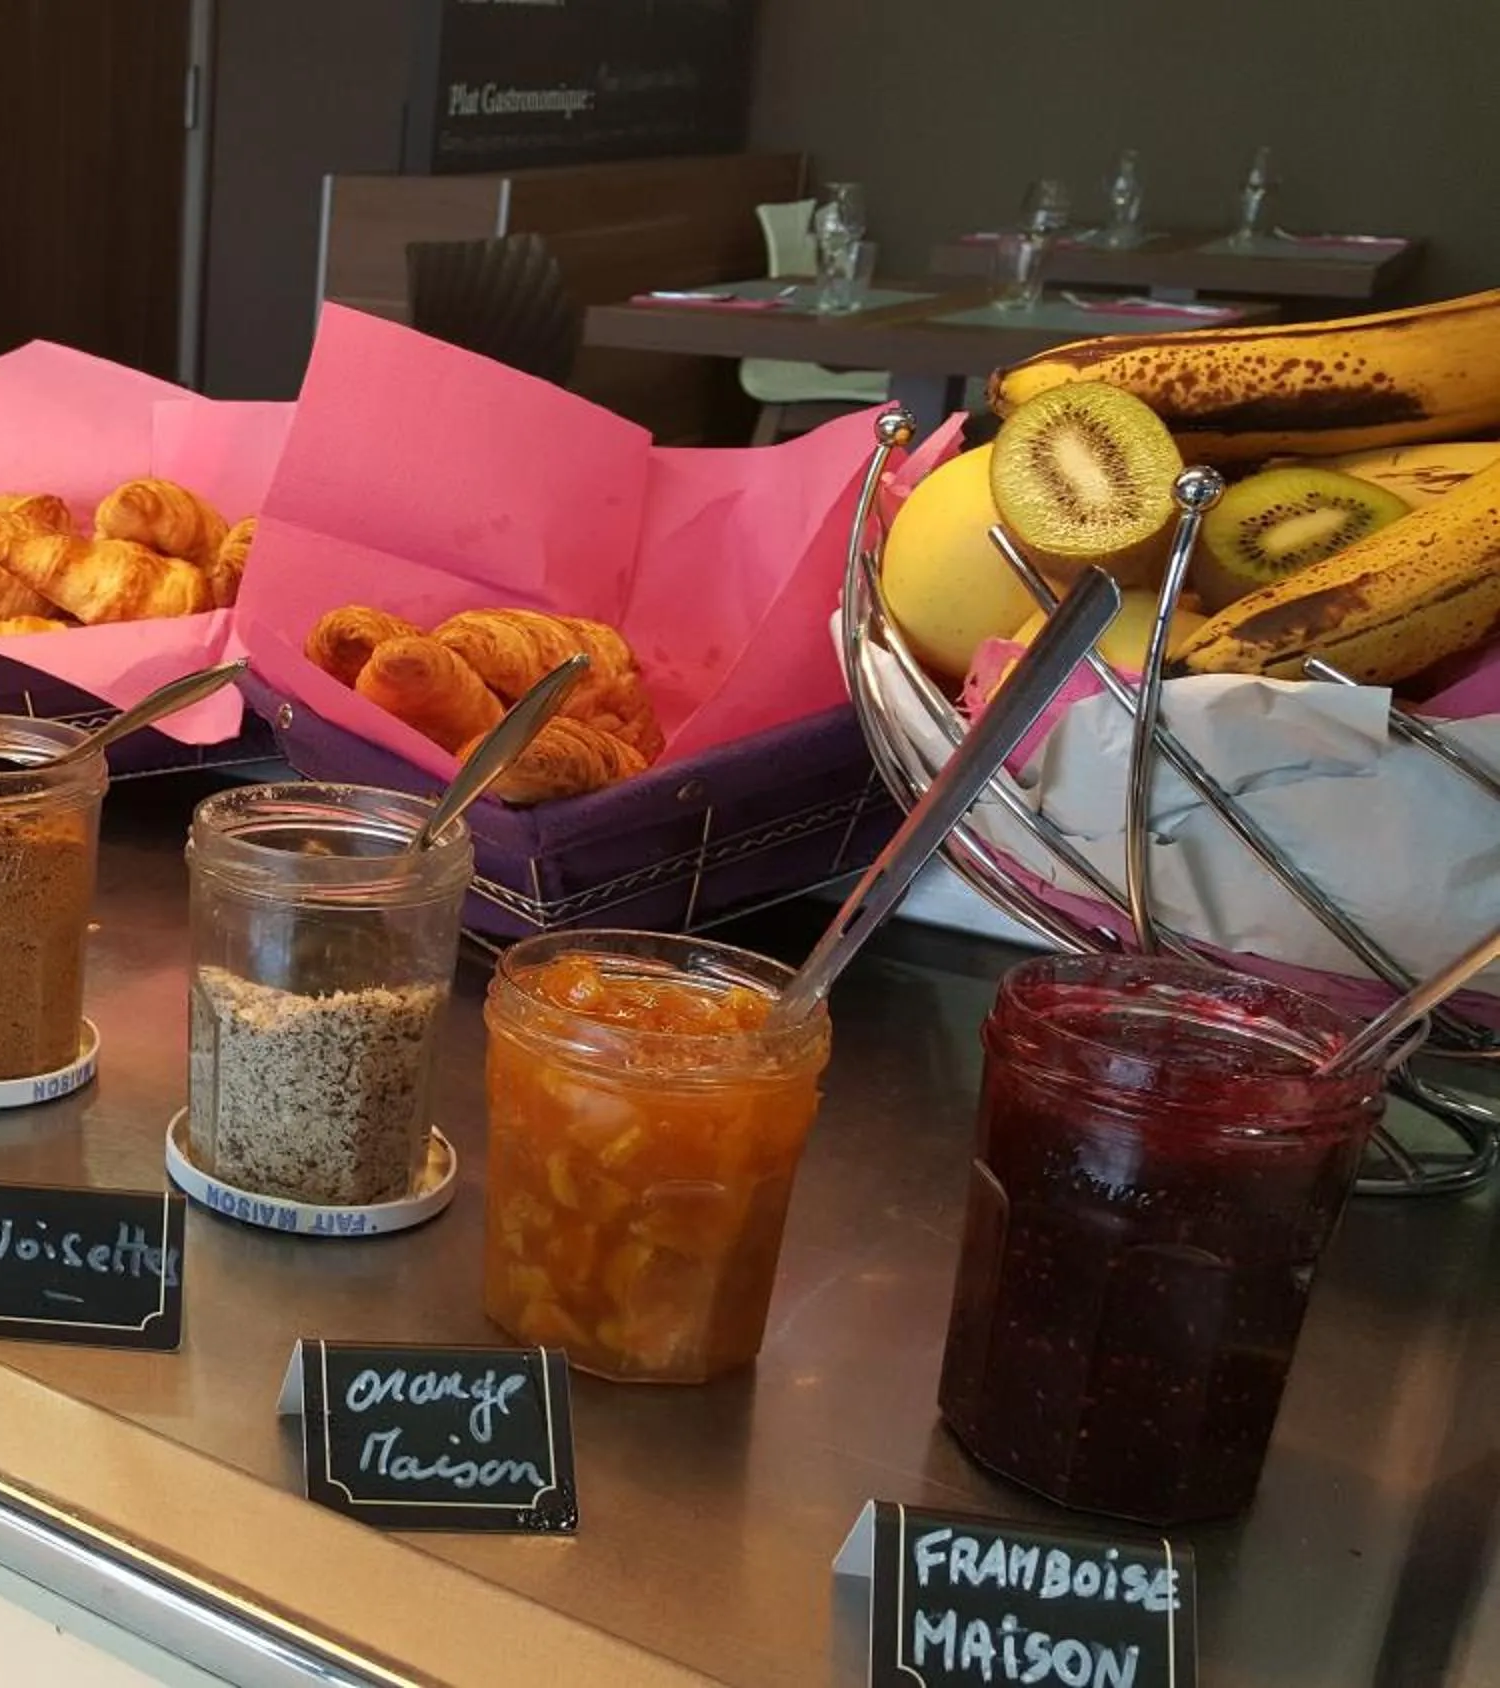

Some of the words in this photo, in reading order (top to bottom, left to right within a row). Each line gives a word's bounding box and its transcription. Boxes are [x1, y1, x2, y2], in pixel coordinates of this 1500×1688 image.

[205, 1182, 298, 1231] MAISON
[308, 1212, 368, 1233] FAIT
[359, 1427, 546, 1488] Maison
